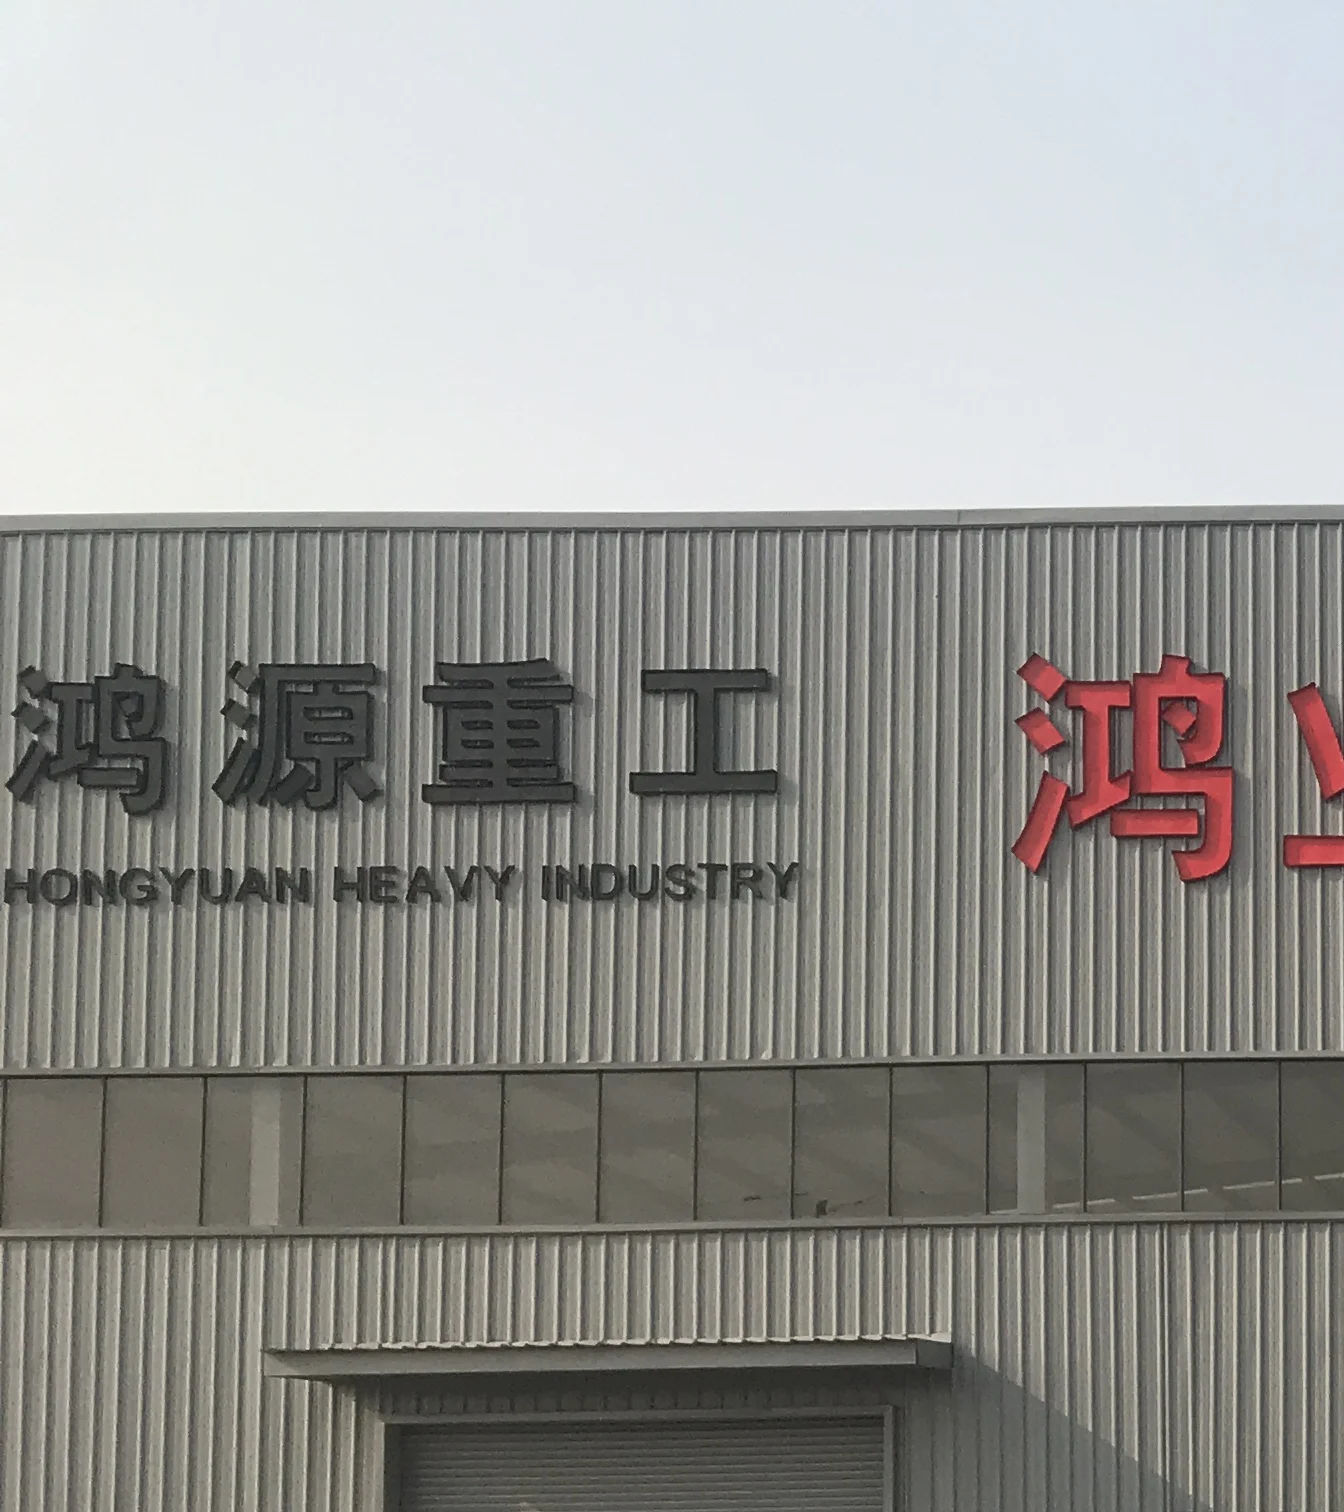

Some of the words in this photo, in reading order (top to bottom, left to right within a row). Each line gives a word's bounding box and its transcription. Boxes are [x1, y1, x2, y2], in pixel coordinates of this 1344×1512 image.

[5, 658, 781, 815] 鸿源重工
[3, 866, 312, 906] HONGYUAN
[332, 865, 518, 903] HEAVY
[541, 862, 801, 902] INDUSTRY
